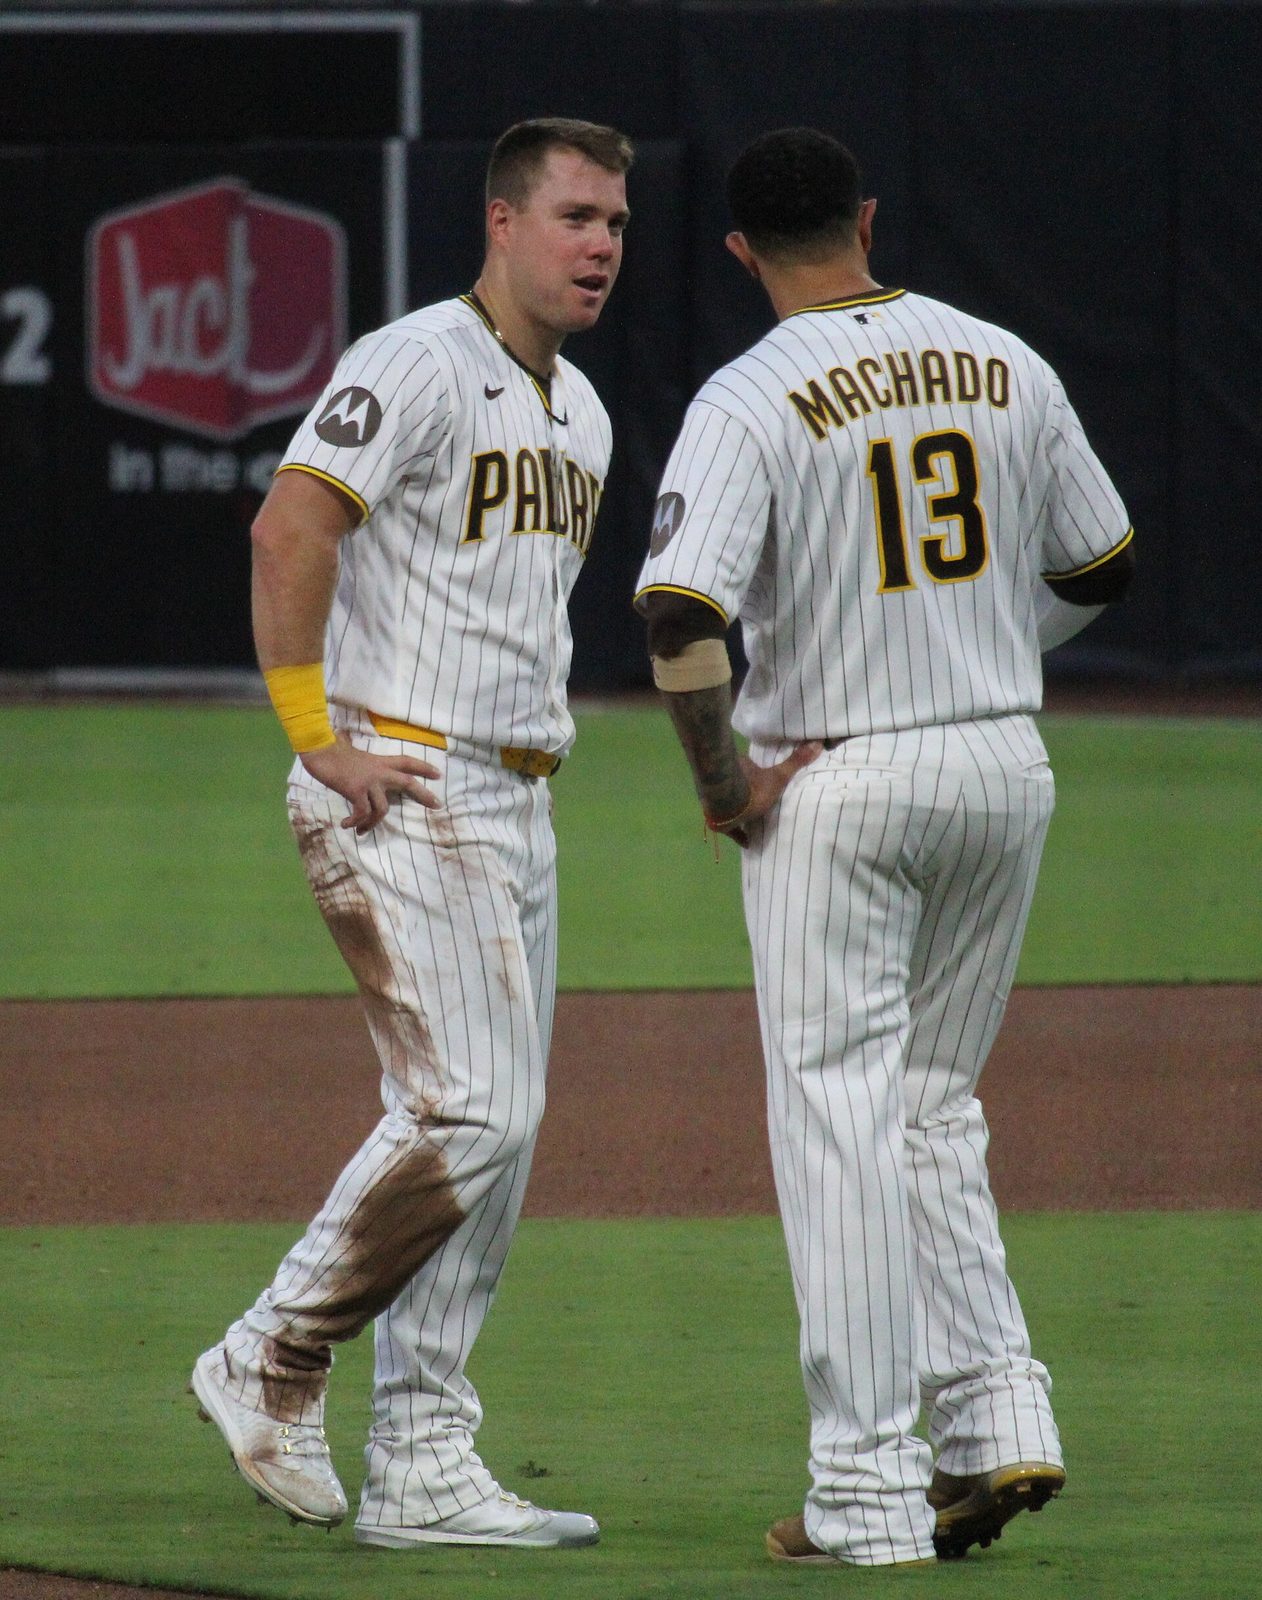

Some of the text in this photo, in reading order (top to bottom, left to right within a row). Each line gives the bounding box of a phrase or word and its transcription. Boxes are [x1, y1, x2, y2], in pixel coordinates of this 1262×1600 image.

[0, 287, 51, 383] 2
[788, 350, 1009, 442] MACHADO
[866, 428, 989, 595] 13
